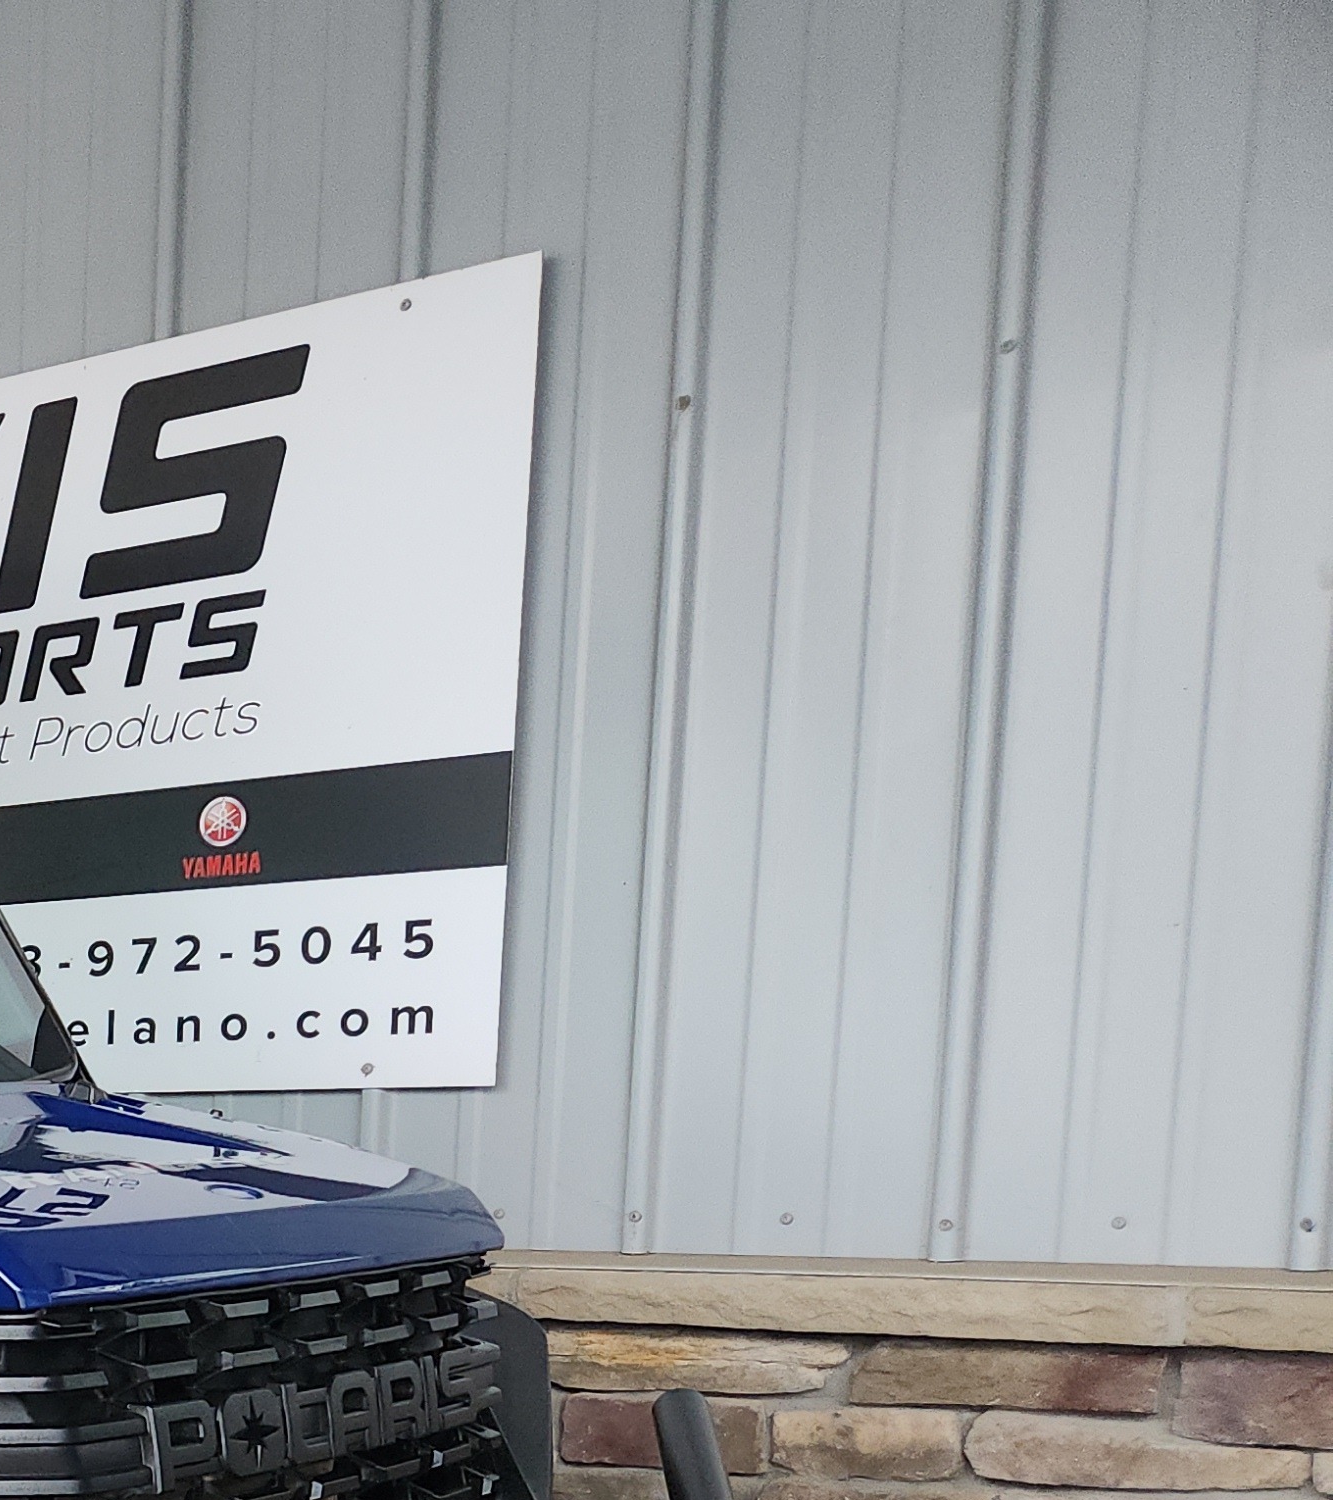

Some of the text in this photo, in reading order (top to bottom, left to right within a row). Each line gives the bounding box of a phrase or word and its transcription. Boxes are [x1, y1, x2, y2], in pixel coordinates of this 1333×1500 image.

[28, 696, 261, 760] Products
[182, 848, 262, 880] YAMAHA
[130, 1335, 501, 1497] POLARIS
